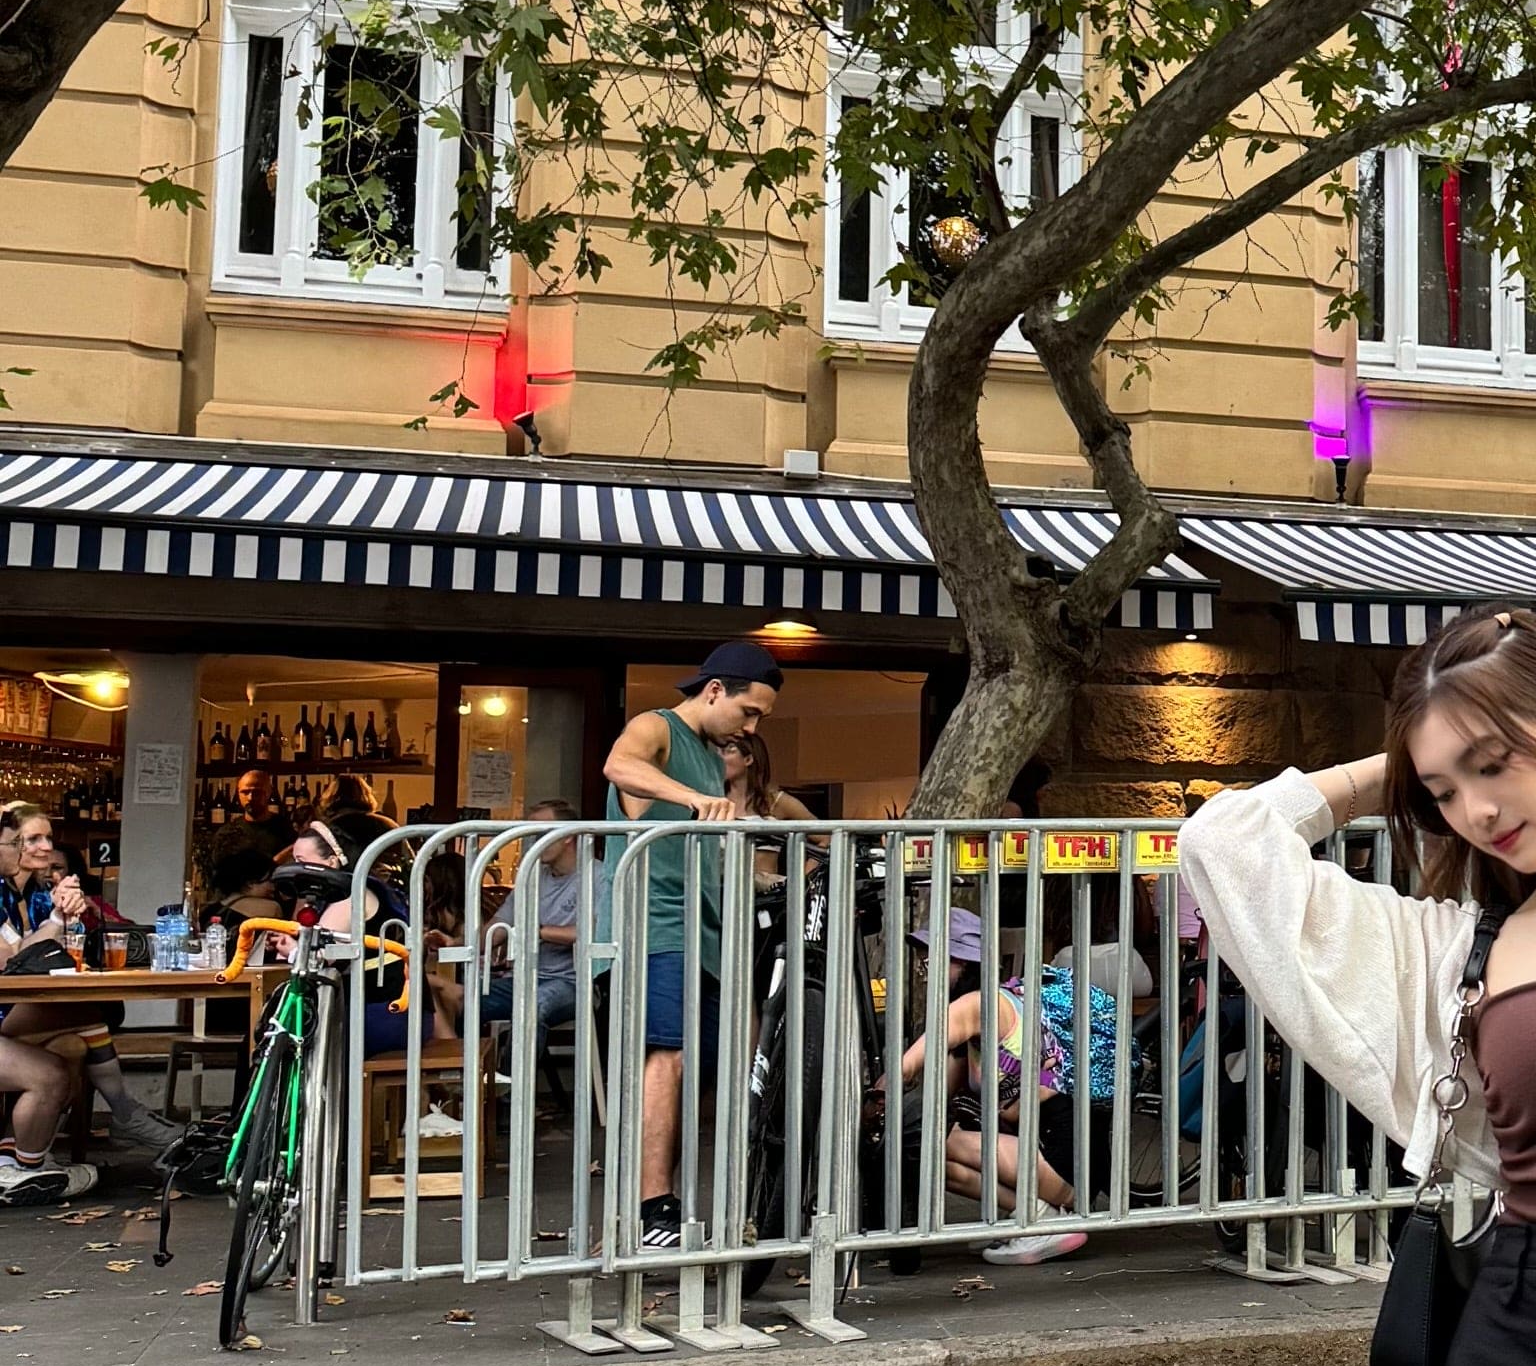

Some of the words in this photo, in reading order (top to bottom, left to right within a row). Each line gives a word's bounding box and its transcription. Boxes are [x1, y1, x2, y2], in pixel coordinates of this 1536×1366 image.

[99, 843, 111, 863] 2
[1053, 836, 1105, 859] TFH
[1149, 835, 1177, 852] TF
